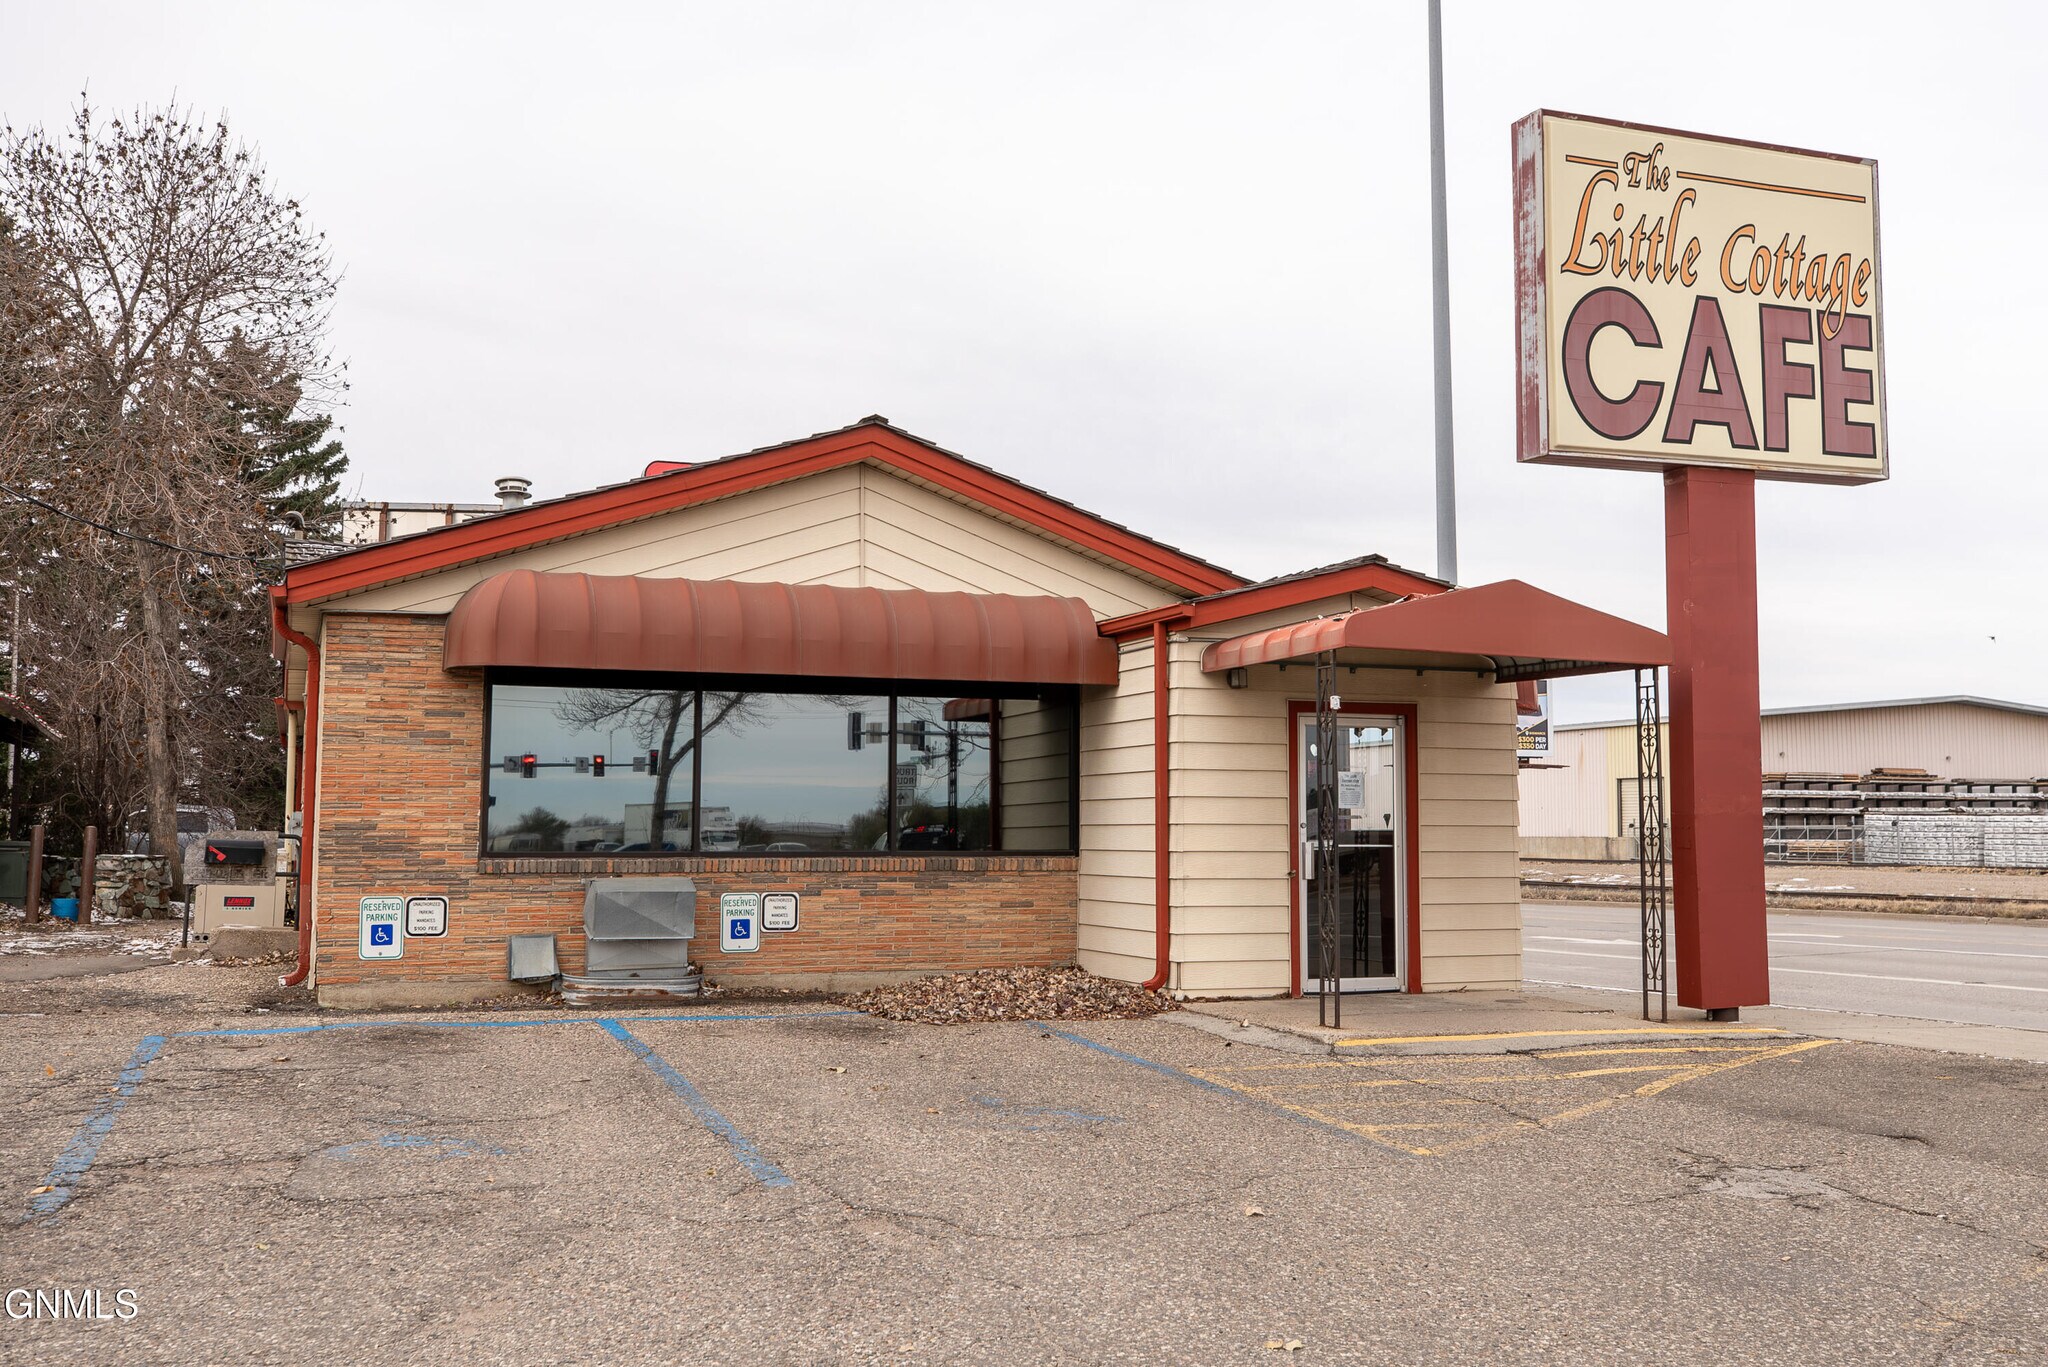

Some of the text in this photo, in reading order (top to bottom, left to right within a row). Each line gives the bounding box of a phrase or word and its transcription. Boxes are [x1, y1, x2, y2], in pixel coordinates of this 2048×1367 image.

[1623, 142, 1671, 192] The
[1561, 169, 1872, 341] Little Cottage
[1561, 286, 1877, 459] CAFE
[363, 902, 400, 912] RESERVED
[723, 898, 757, 907] RESERVED
[365, 913, 398, 922] PARKING
[726, 908, 755, 917] PARKING
